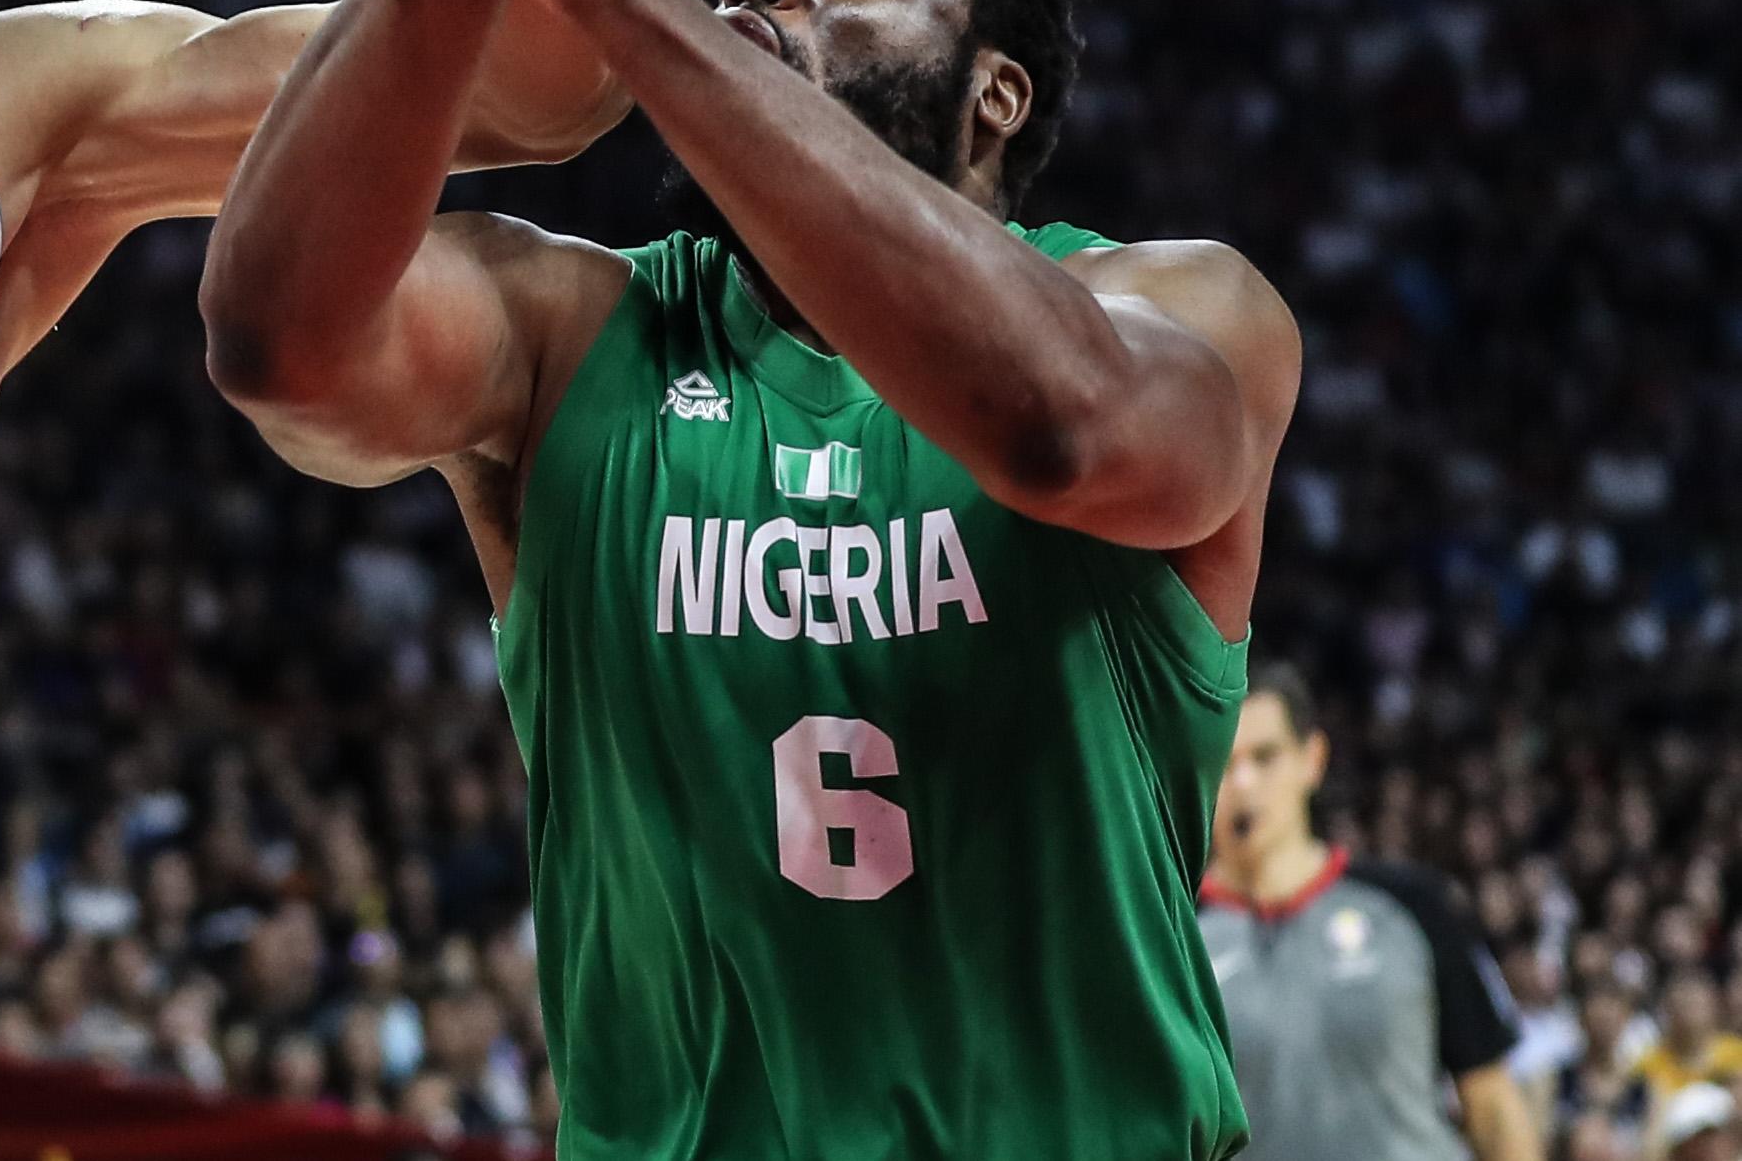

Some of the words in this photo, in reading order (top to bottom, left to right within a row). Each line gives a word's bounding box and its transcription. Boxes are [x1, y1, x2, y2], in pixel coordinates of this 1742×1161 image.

[660, 387, 731, 422] PEAK
[657, 508, 988, 644] NIGERIA
[773, 716, 914, 900] 6
